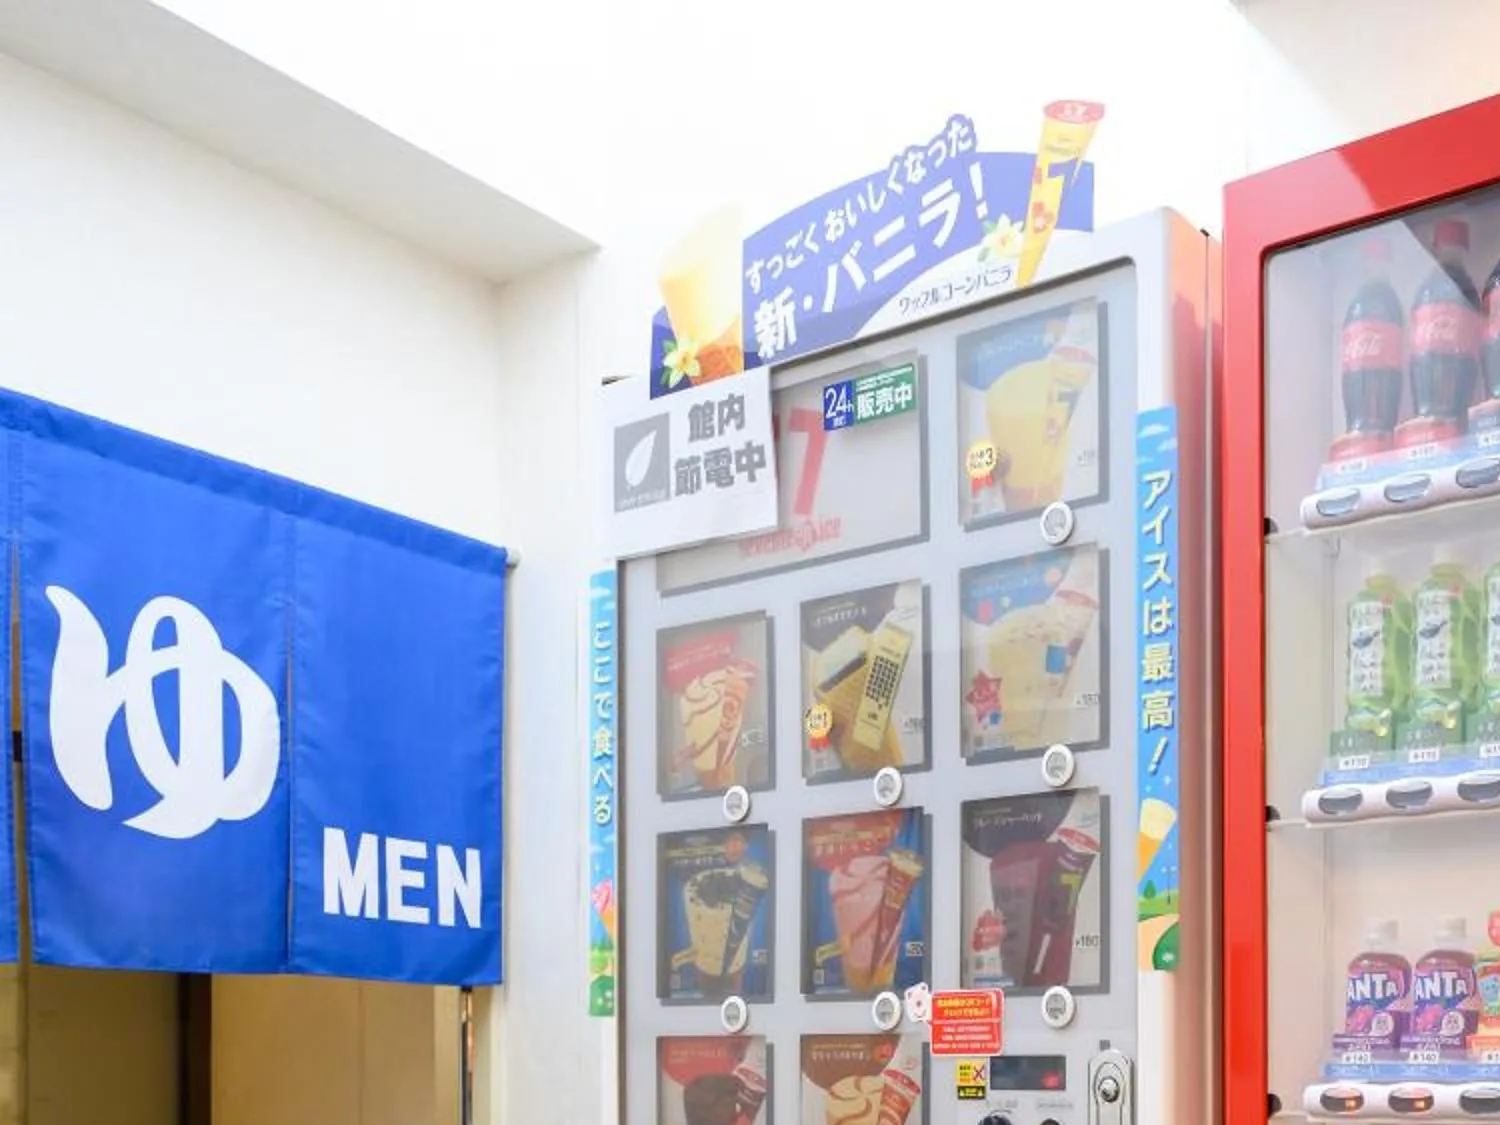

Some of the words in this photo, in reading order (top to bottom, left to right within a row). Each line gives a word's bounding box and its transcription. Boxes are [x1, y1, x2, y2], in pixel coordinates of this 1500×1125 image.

[688, 391, 746, 442] 館内
[856, 382, 913, 420] 販売中
[673, 440, 767, 496] 節電中
[44, 584, 281, 840] ゆ
[322, 826, 483, 930] MEN
